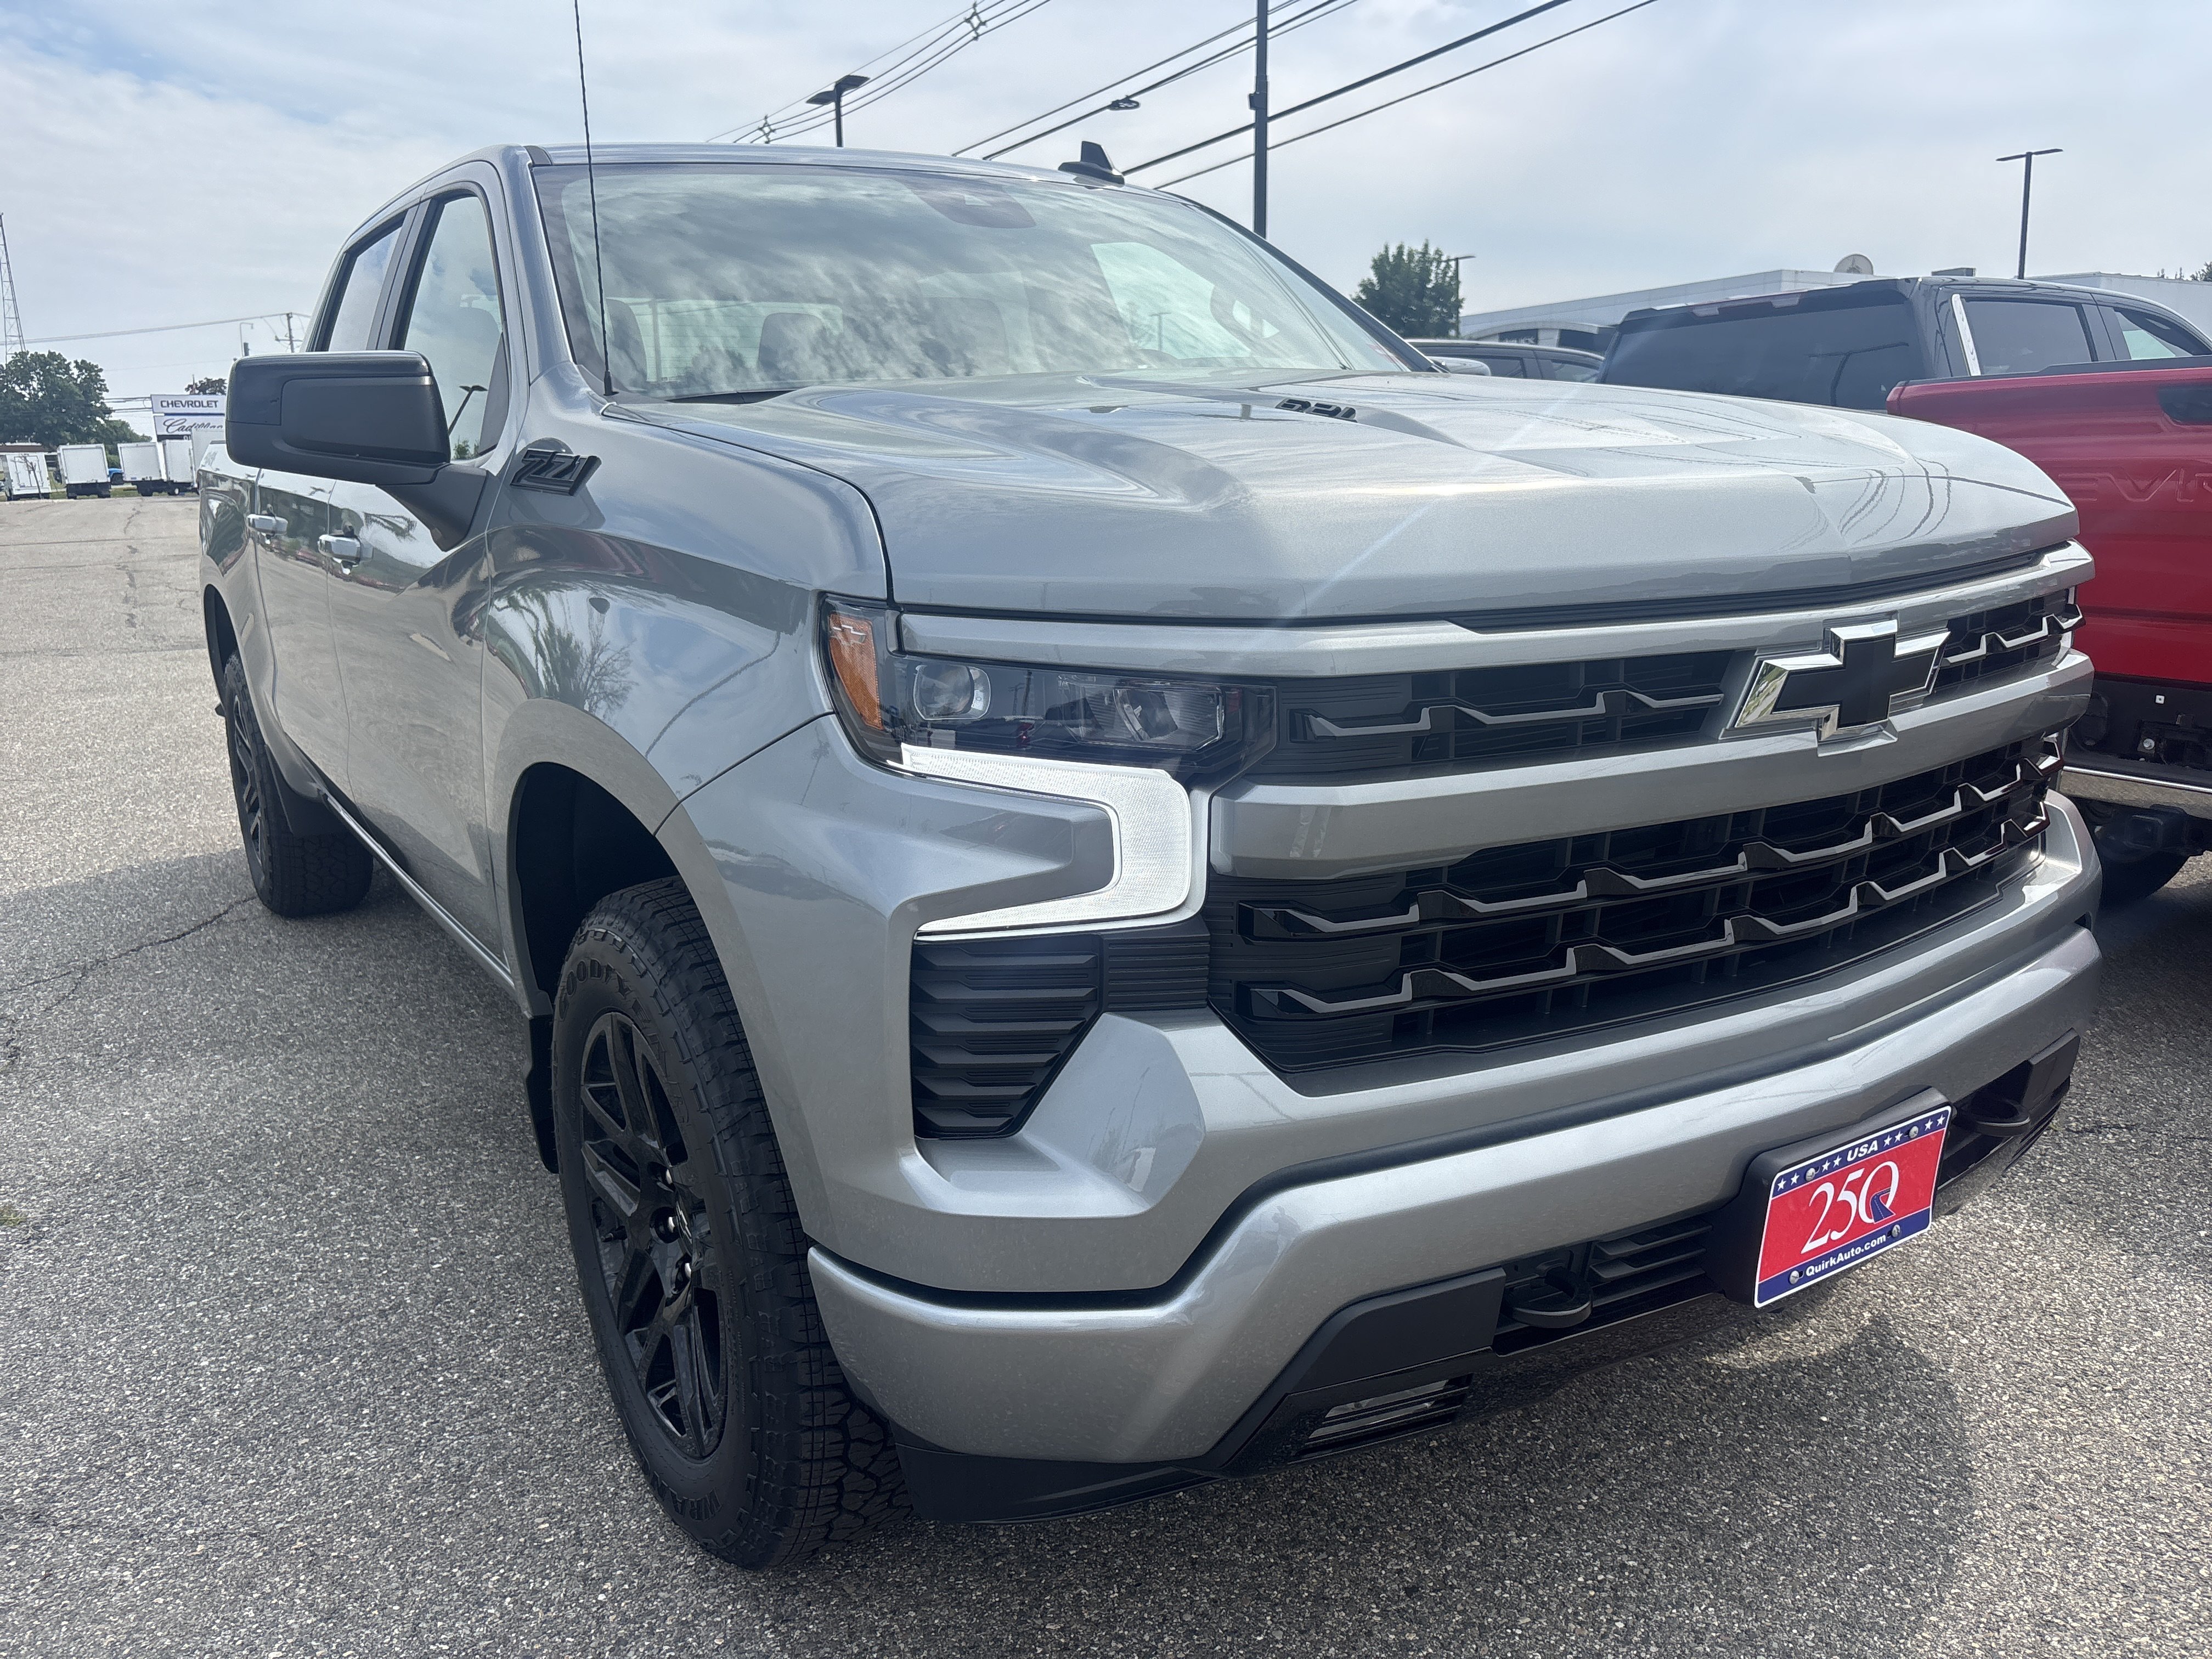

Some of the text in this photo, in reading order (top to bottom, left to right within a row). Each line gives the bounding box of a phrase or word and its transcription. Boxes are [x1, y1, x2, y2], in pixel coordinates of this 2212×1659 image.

[160, 400, 219, 408] CHEVROLET
[1847, 1140, 1878, 1162] USA
[1805, 1234, 1886, 1277] QuirkAuto.com
